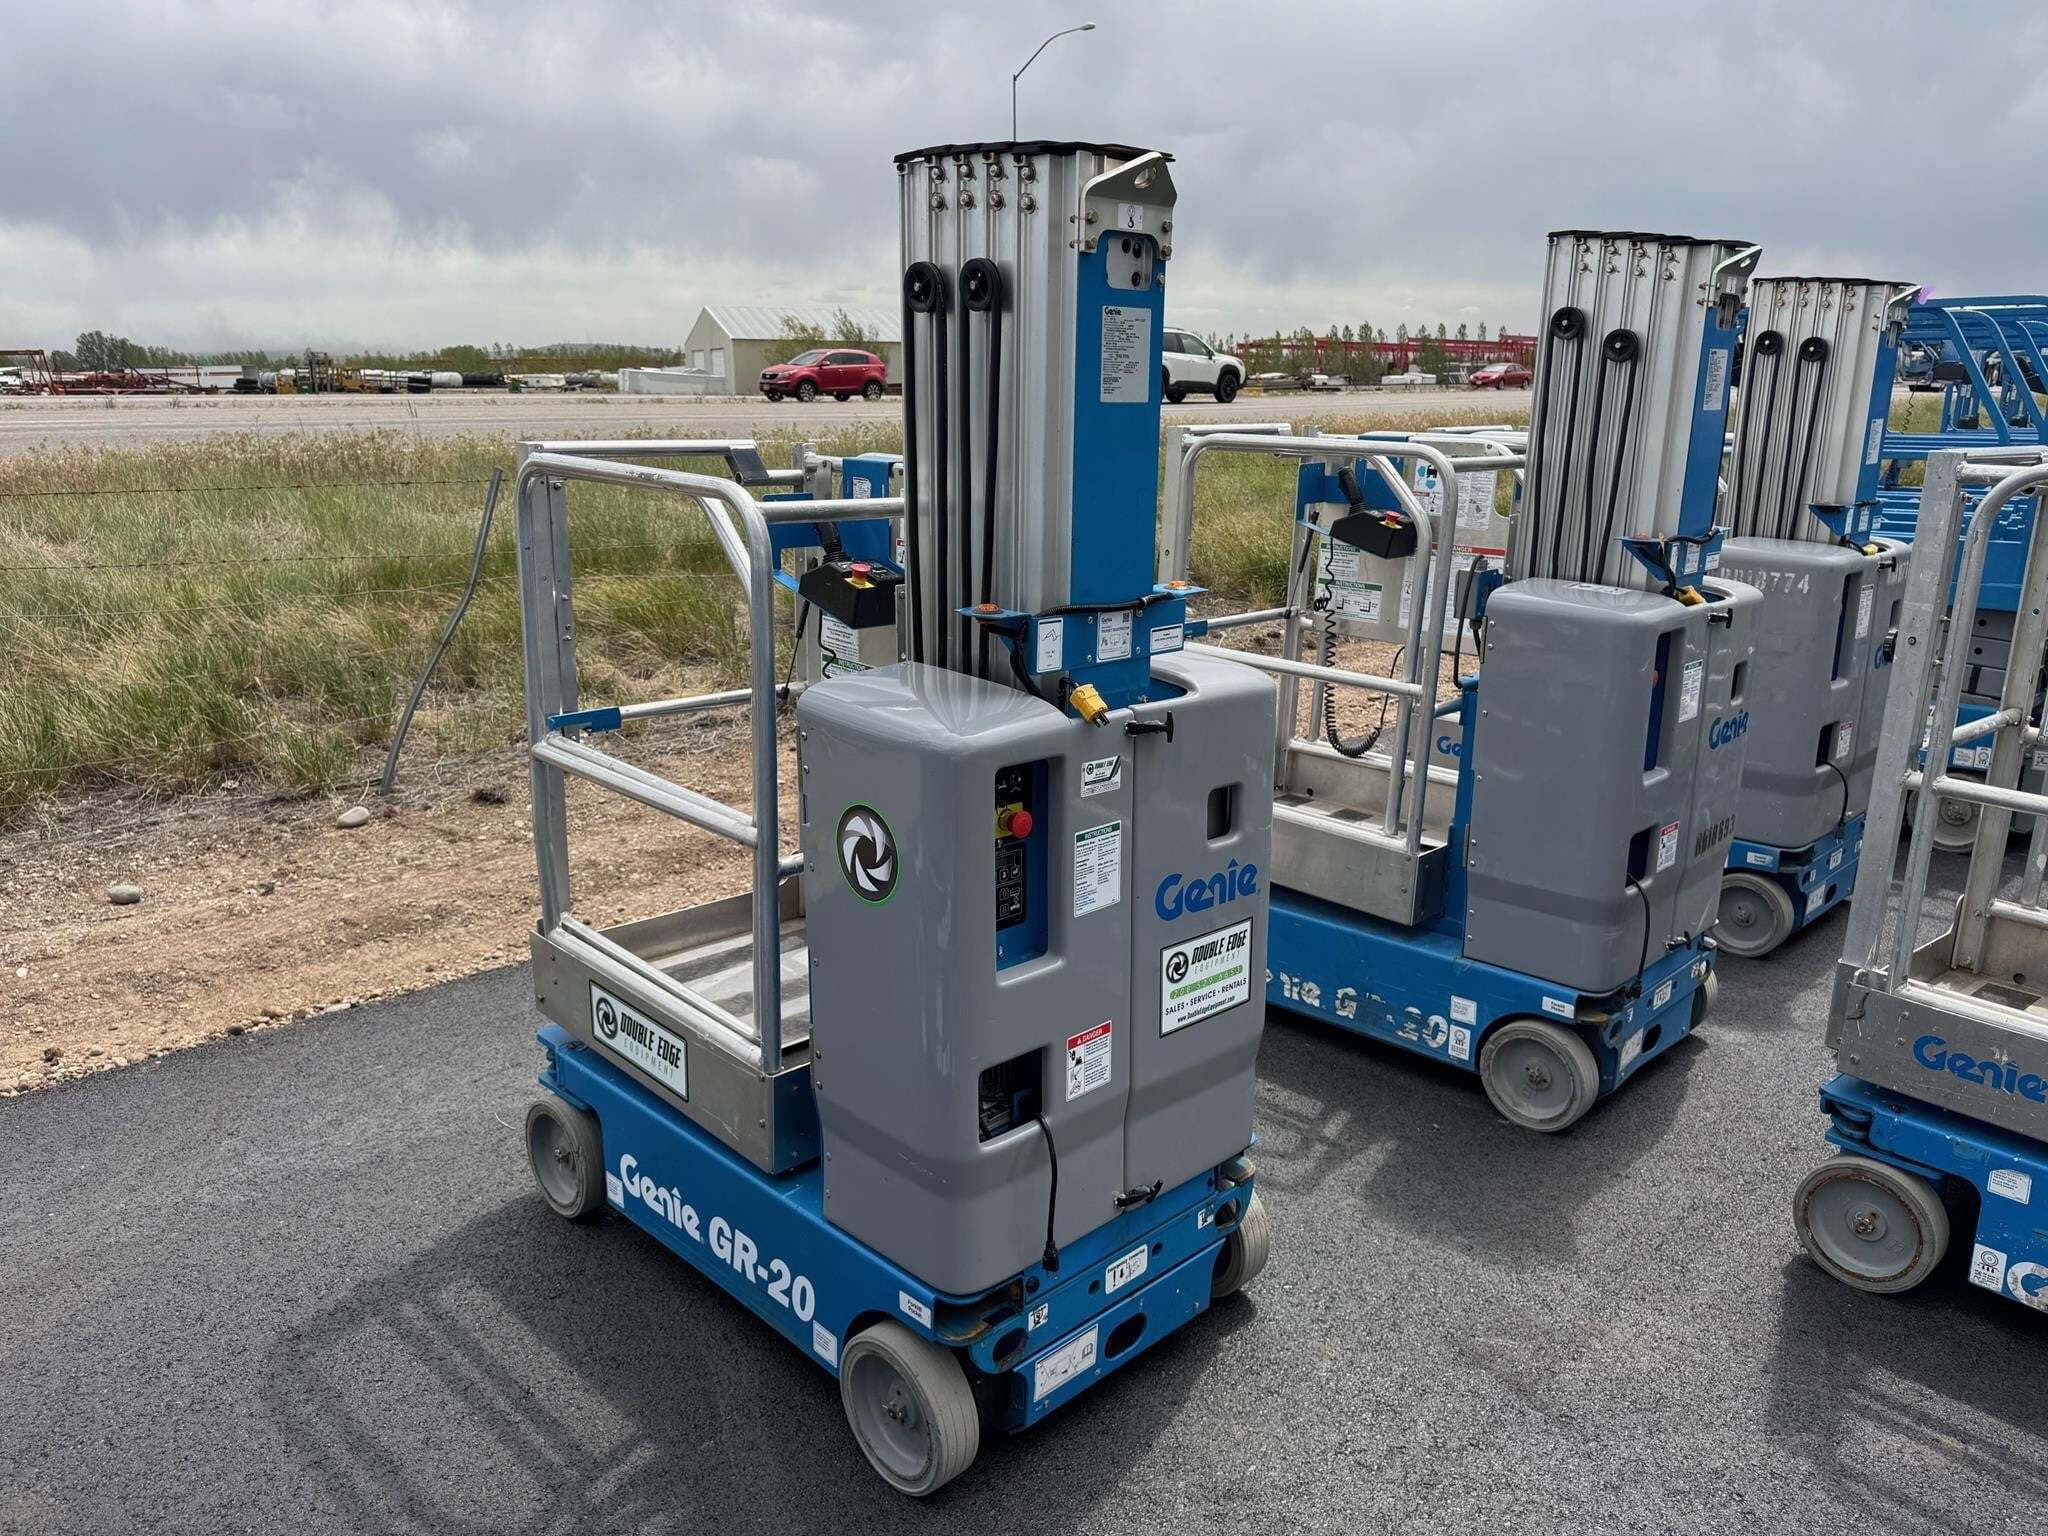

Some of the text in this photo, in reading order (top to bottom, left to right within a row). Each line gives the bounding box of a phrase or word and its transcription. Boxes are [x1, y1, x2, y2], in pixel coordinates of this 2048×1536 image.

[1104, 306, 1122, 316] Genie
[1084, 825, 1113, 840] INSTRUCTIONS
[1155, 858, 1258, 921] Genie
[1191, 929, 1248, 966] DOUBLE EDGE
[1194, 950, 1242, 974] EQUIPMENT
[1165, 977, 1247, 1016] SALES SERVICE RENTALS
[620, 1011, 682, 1069] DOUBLE EDGE
[1082, 1028, 1103, 1042] DANGER
[624, 1037, 674, 1079] EQUIPMENT
[1913, 1034, 2048, 1104] Genie
[620, 1153, 816, 1322] Genie GR-20
